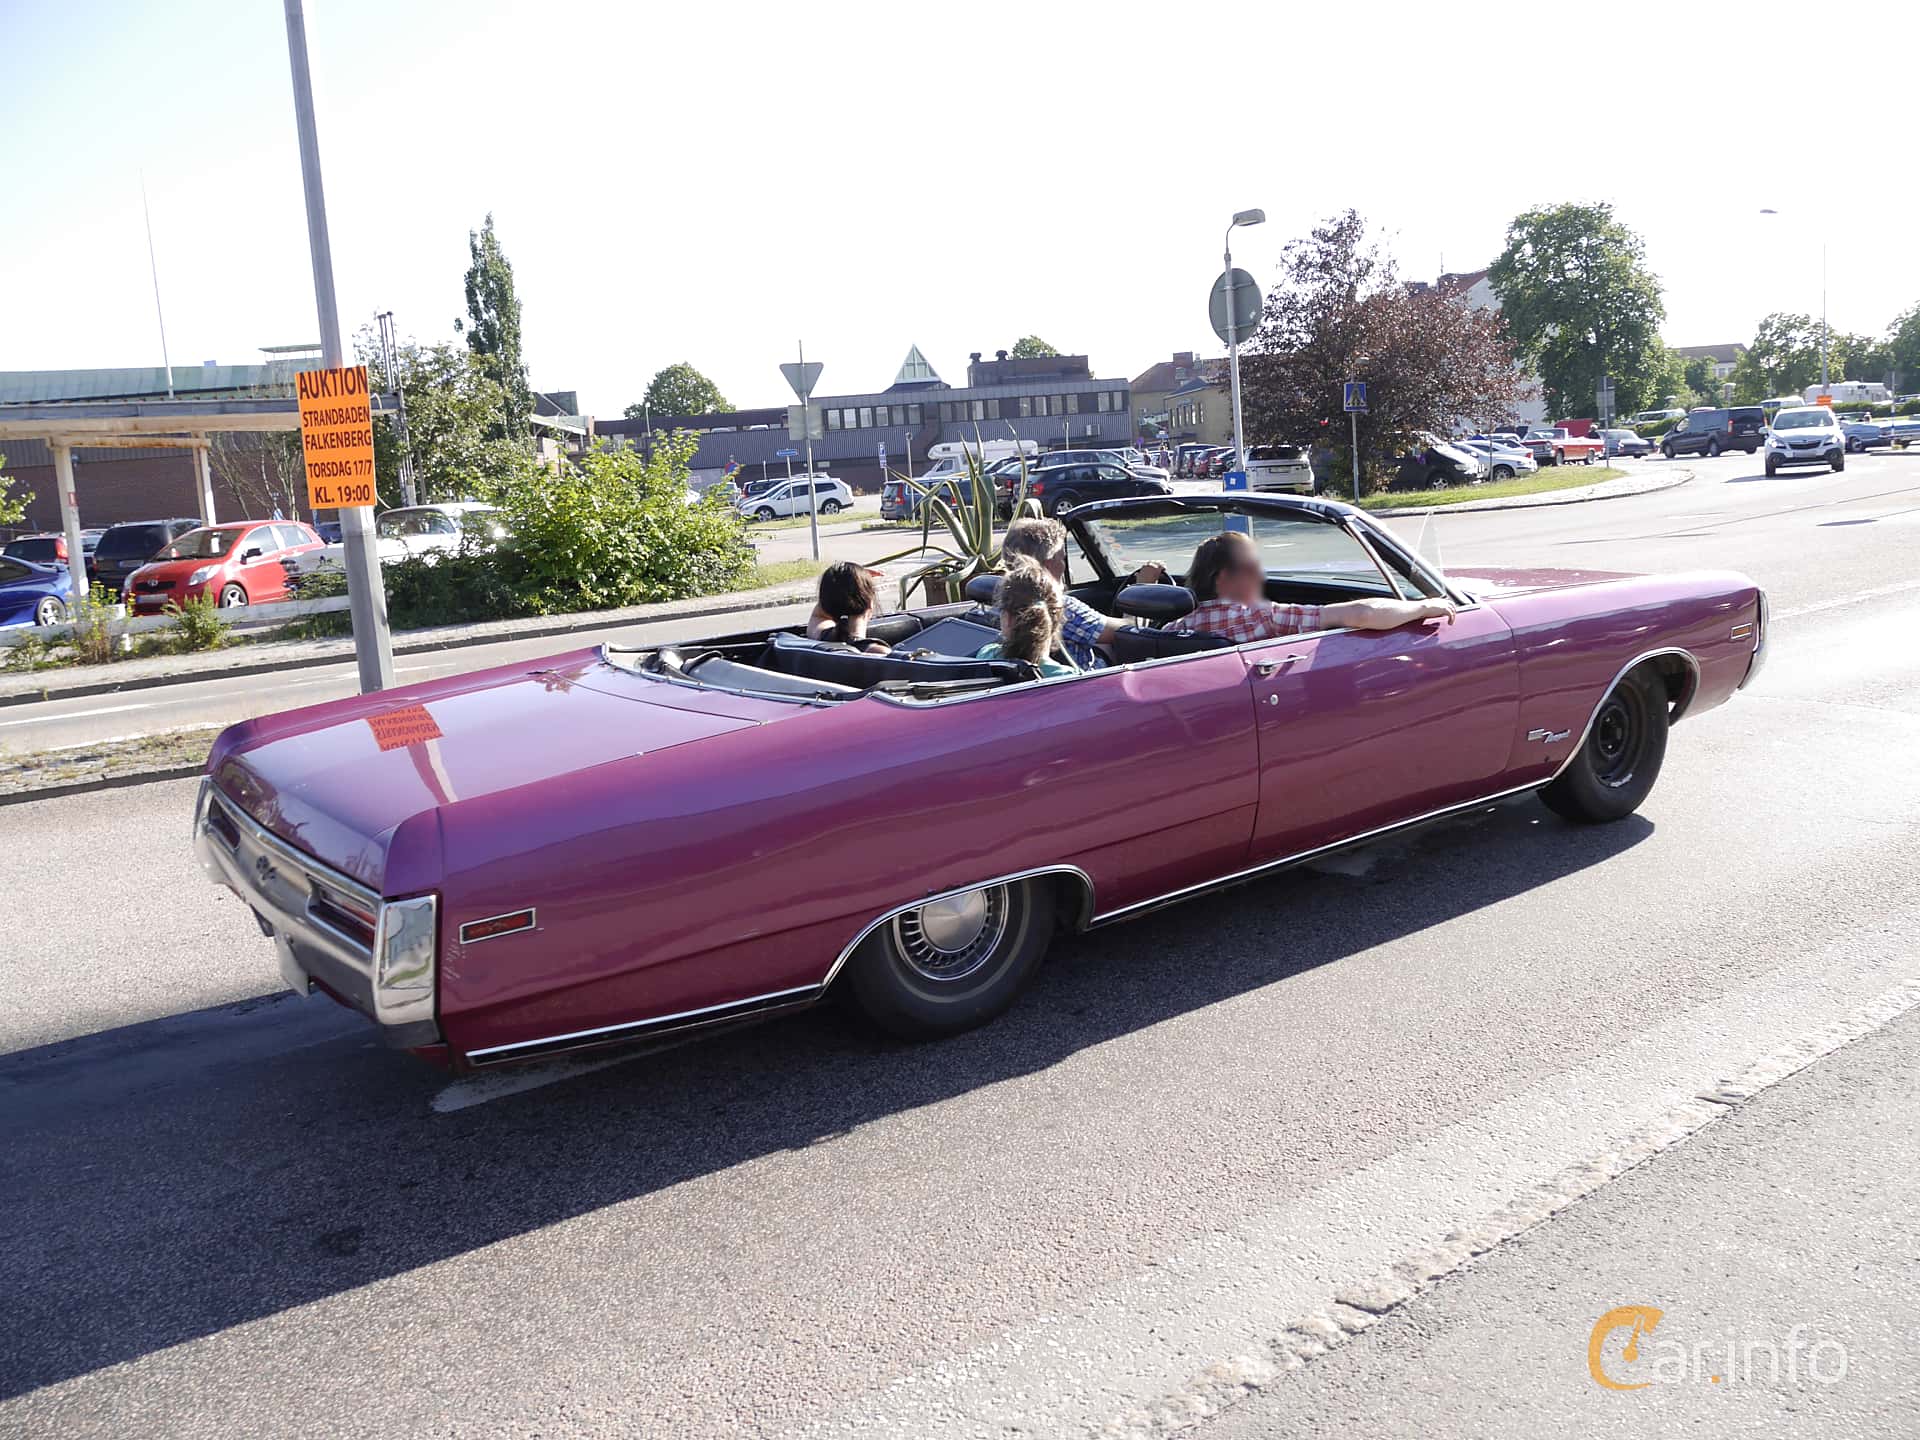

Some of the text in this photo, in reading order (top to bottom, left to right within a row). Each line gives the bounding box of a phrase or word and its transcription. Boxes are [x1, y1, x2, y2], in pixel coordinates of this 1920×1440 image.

[299, 365, 369, 400] AUKTION
[303, 406, 370, 428] STRANDBADEN
[305, 429, 372, 451] FALKENBERG
[308, 459, 372, 479] TORSDAG 17/7
[315, 484, 370, 503] KL. 19:00
